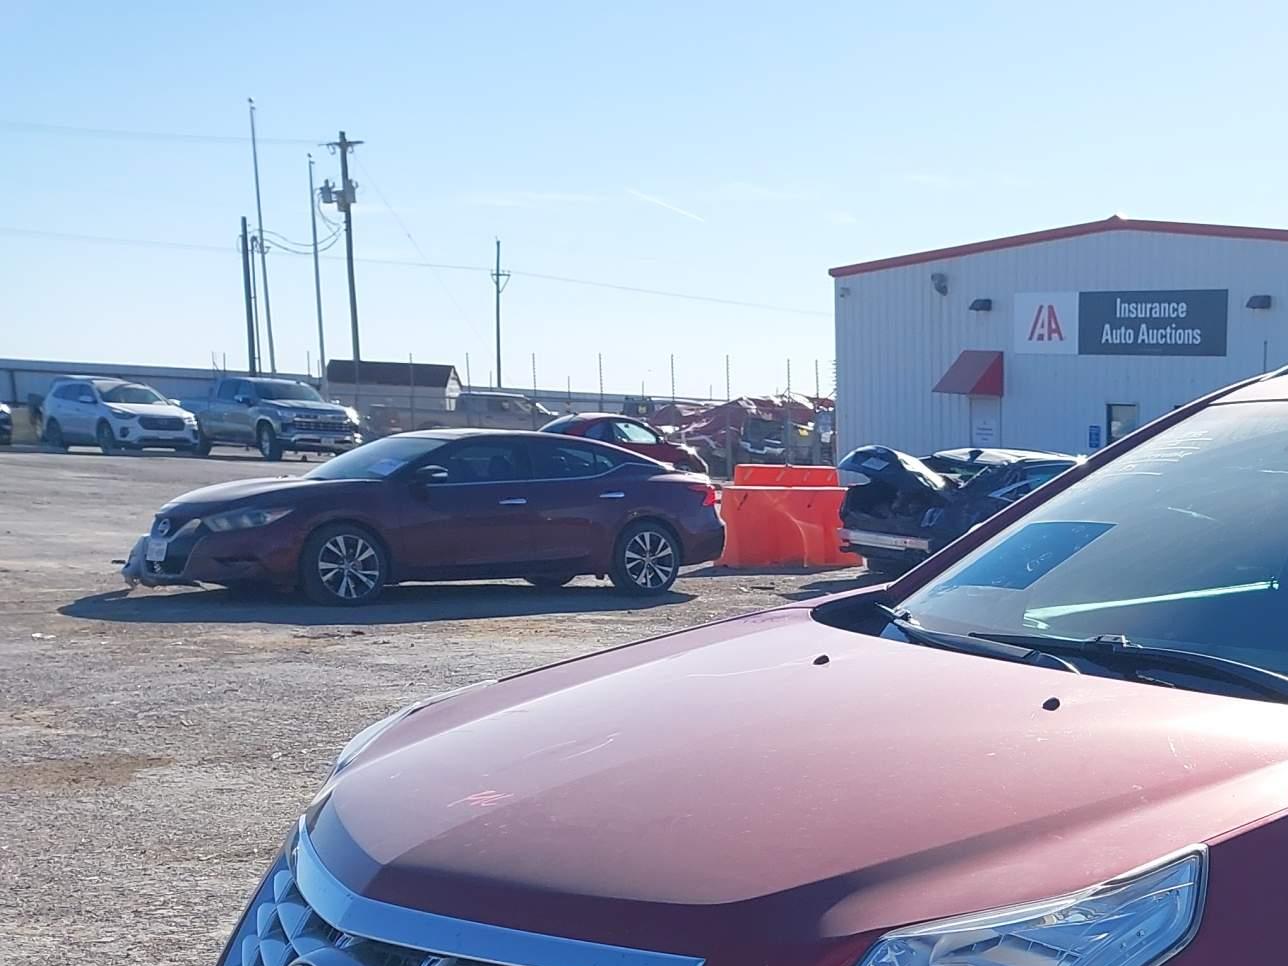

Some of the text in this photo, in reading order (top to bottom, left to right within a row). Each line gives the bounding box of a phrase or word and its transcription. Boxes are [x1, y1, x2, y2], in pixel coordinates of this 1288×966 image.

[1116, 298, 1187, 318] Insurance
[1101, 323, 1201, 344] Auto Auctions
